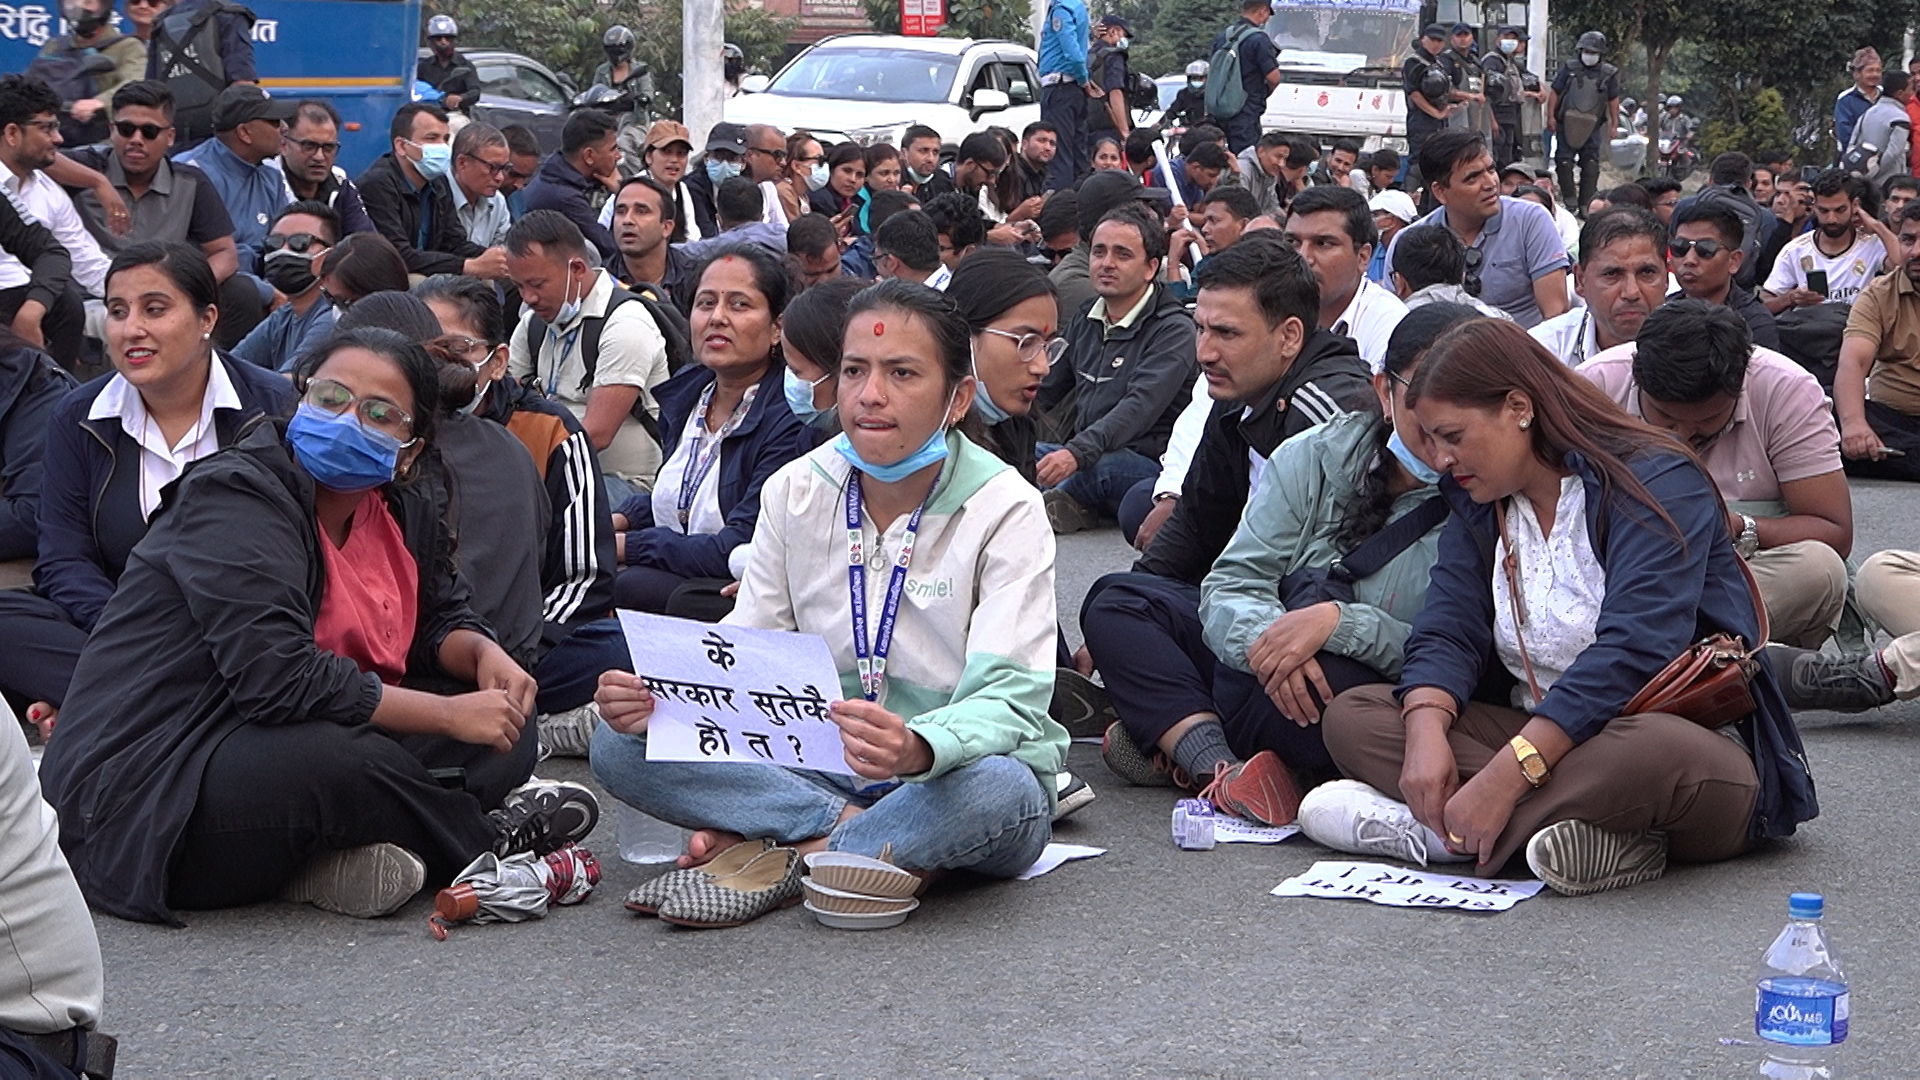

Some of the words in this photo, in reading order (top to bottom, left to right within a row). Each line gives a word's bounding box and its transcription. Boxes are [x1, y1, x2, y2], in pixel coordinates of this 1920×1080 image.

[702, 630, 735, 672] के
[640, 674, 739, 713] सरकार
[748, 684, 829, 726] सुतेकै
[694, 715, 730, 756] हो
[741, 731, 774, 760] त
[787, 734, 804, 763] ?
